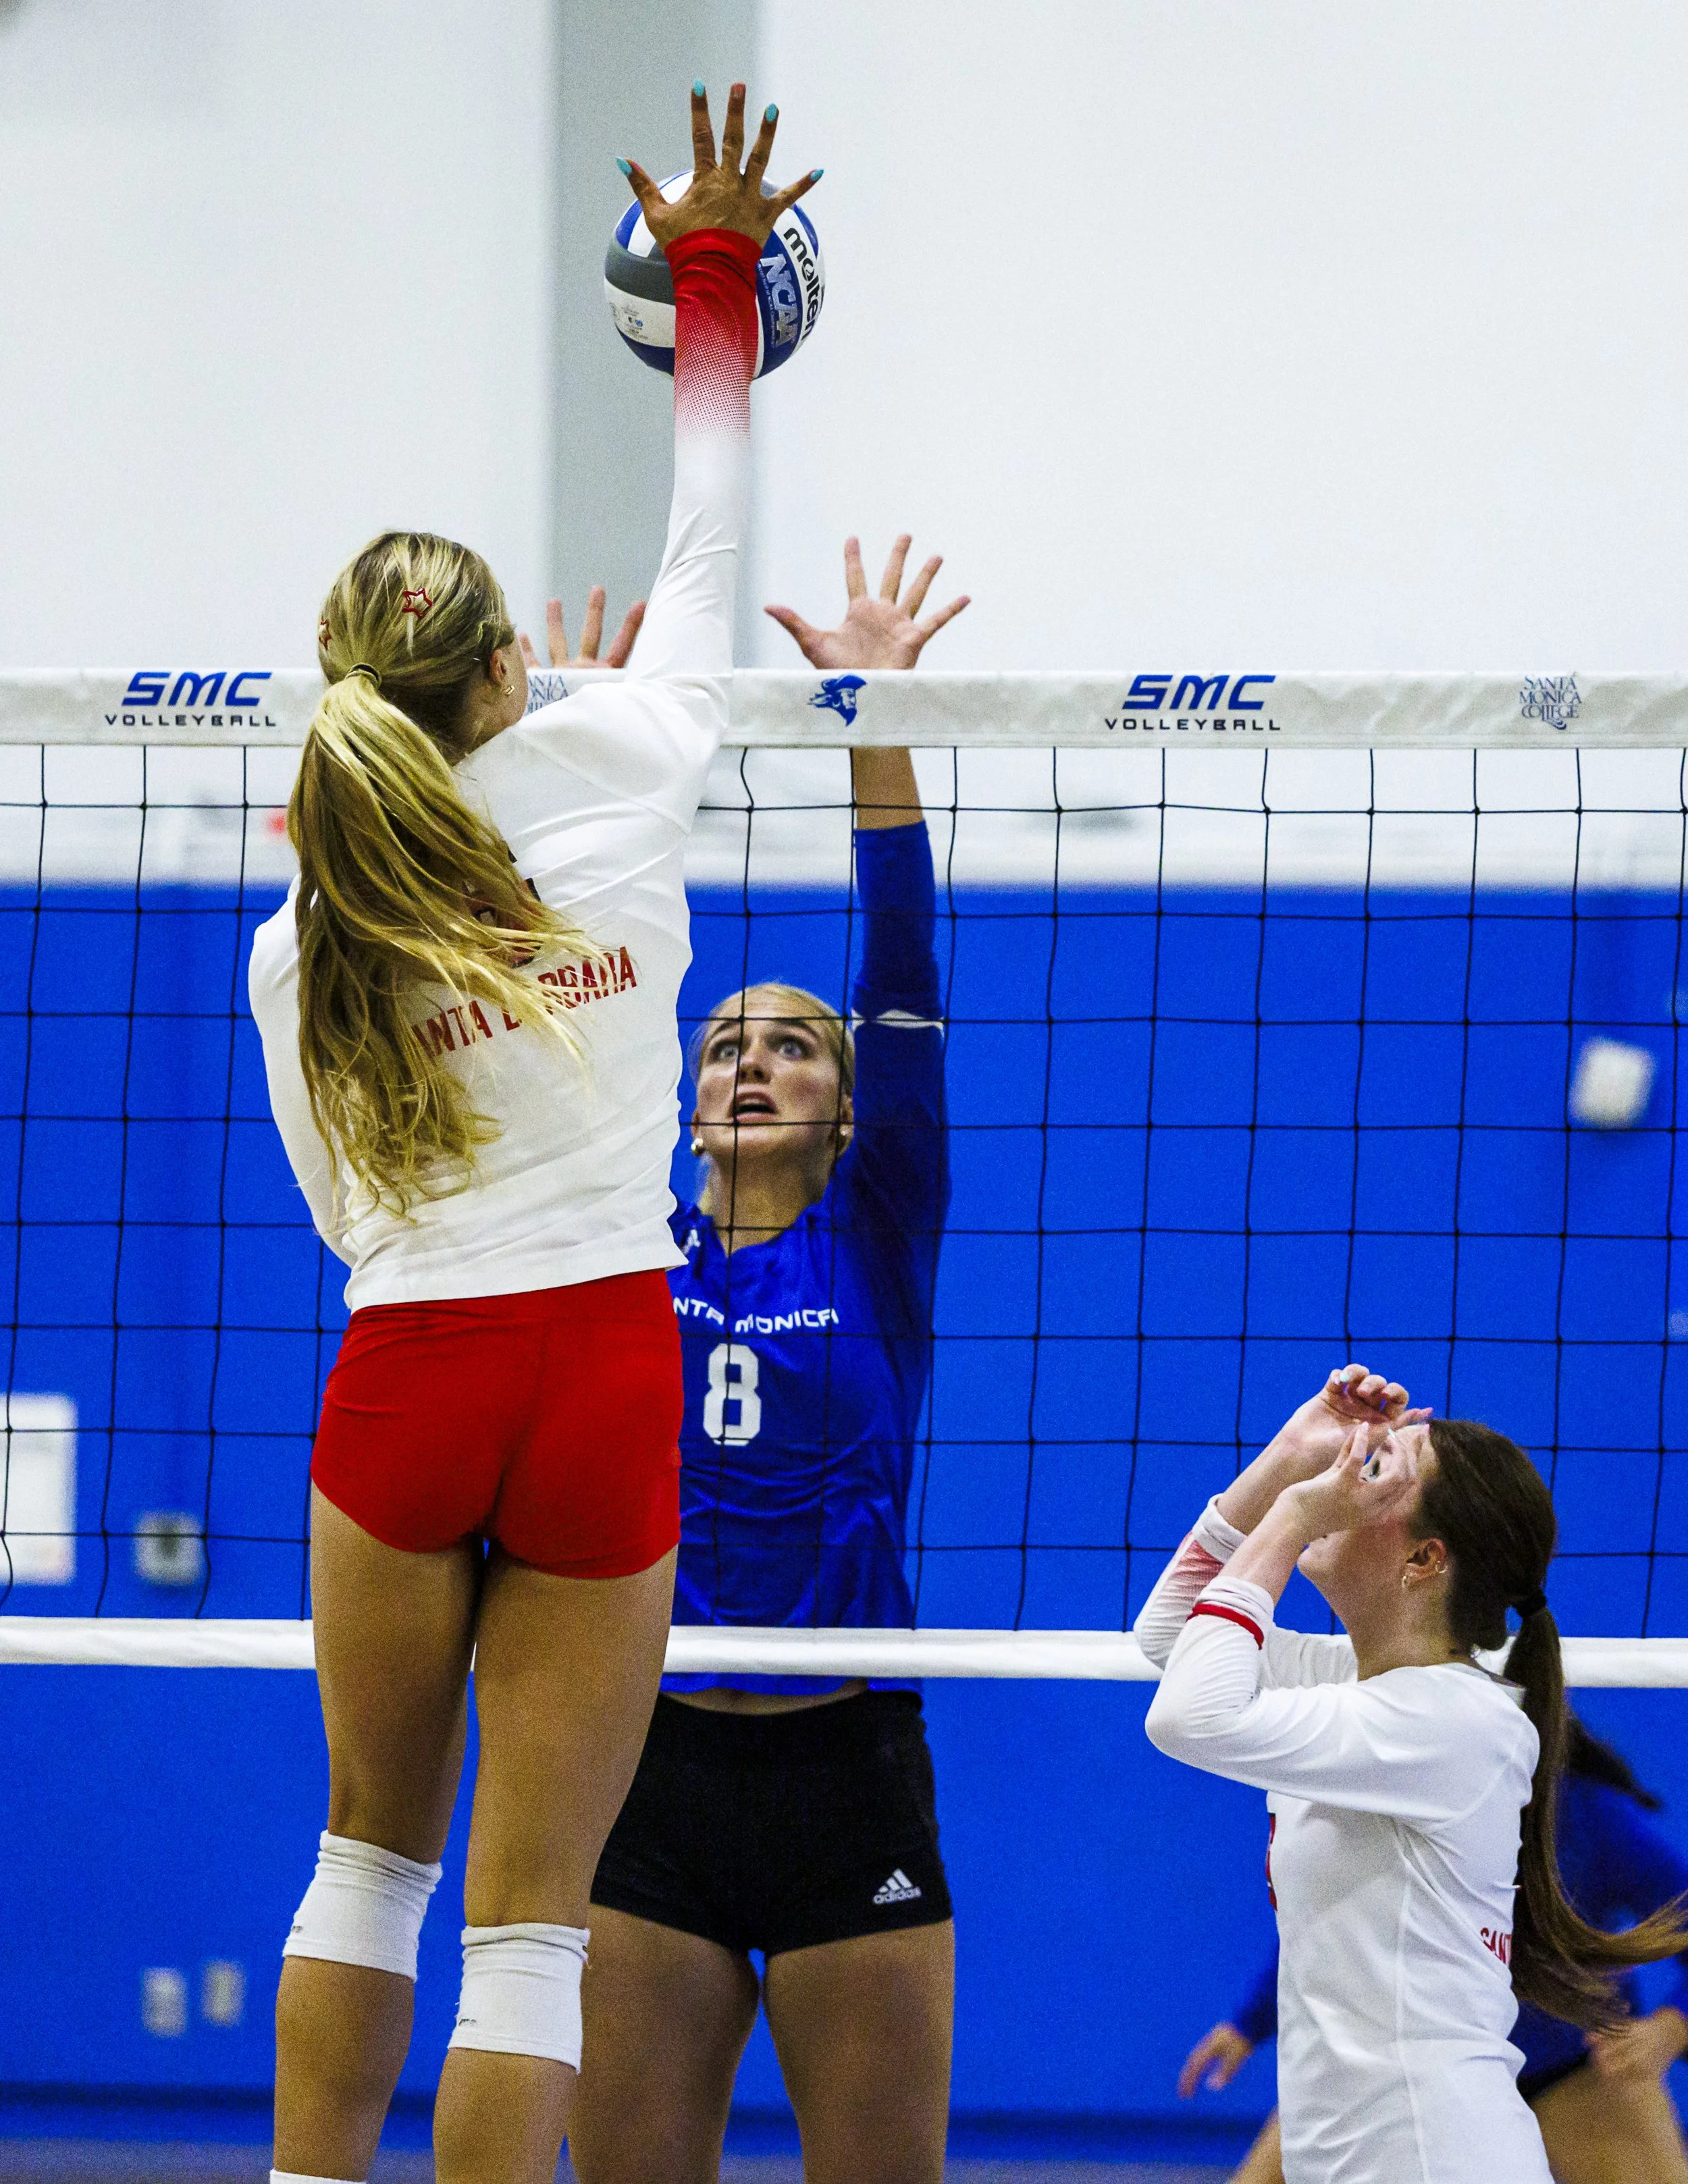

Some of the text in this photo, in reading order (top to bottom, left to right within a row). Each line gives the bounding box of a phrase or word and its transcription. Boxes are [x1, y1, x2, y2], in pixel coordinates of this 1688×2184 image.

[760, 253, 799, 346] NCAA
[783, 228, 820, 340] molten
[122, 672, 272, 706] SMC
[1122, 674, 1275, 710] SMC
[1520, 691, 1582, 703] MONICA
[1523, 674, 1577, 690] SANTA
[105, 714, 276, 726] VOLLEYBALL
[1105, 718, 1280, 730] VOLLEYBALL
[1521, 705, 1579, 725] COLLEGE
[673, 1297, 839, 1334] NTA MONICA
[703, 1343, 761, 1446] 8
[873, 1887, 922, 1905] adidas
[1480, 1927, 1512, 1965] SANT
